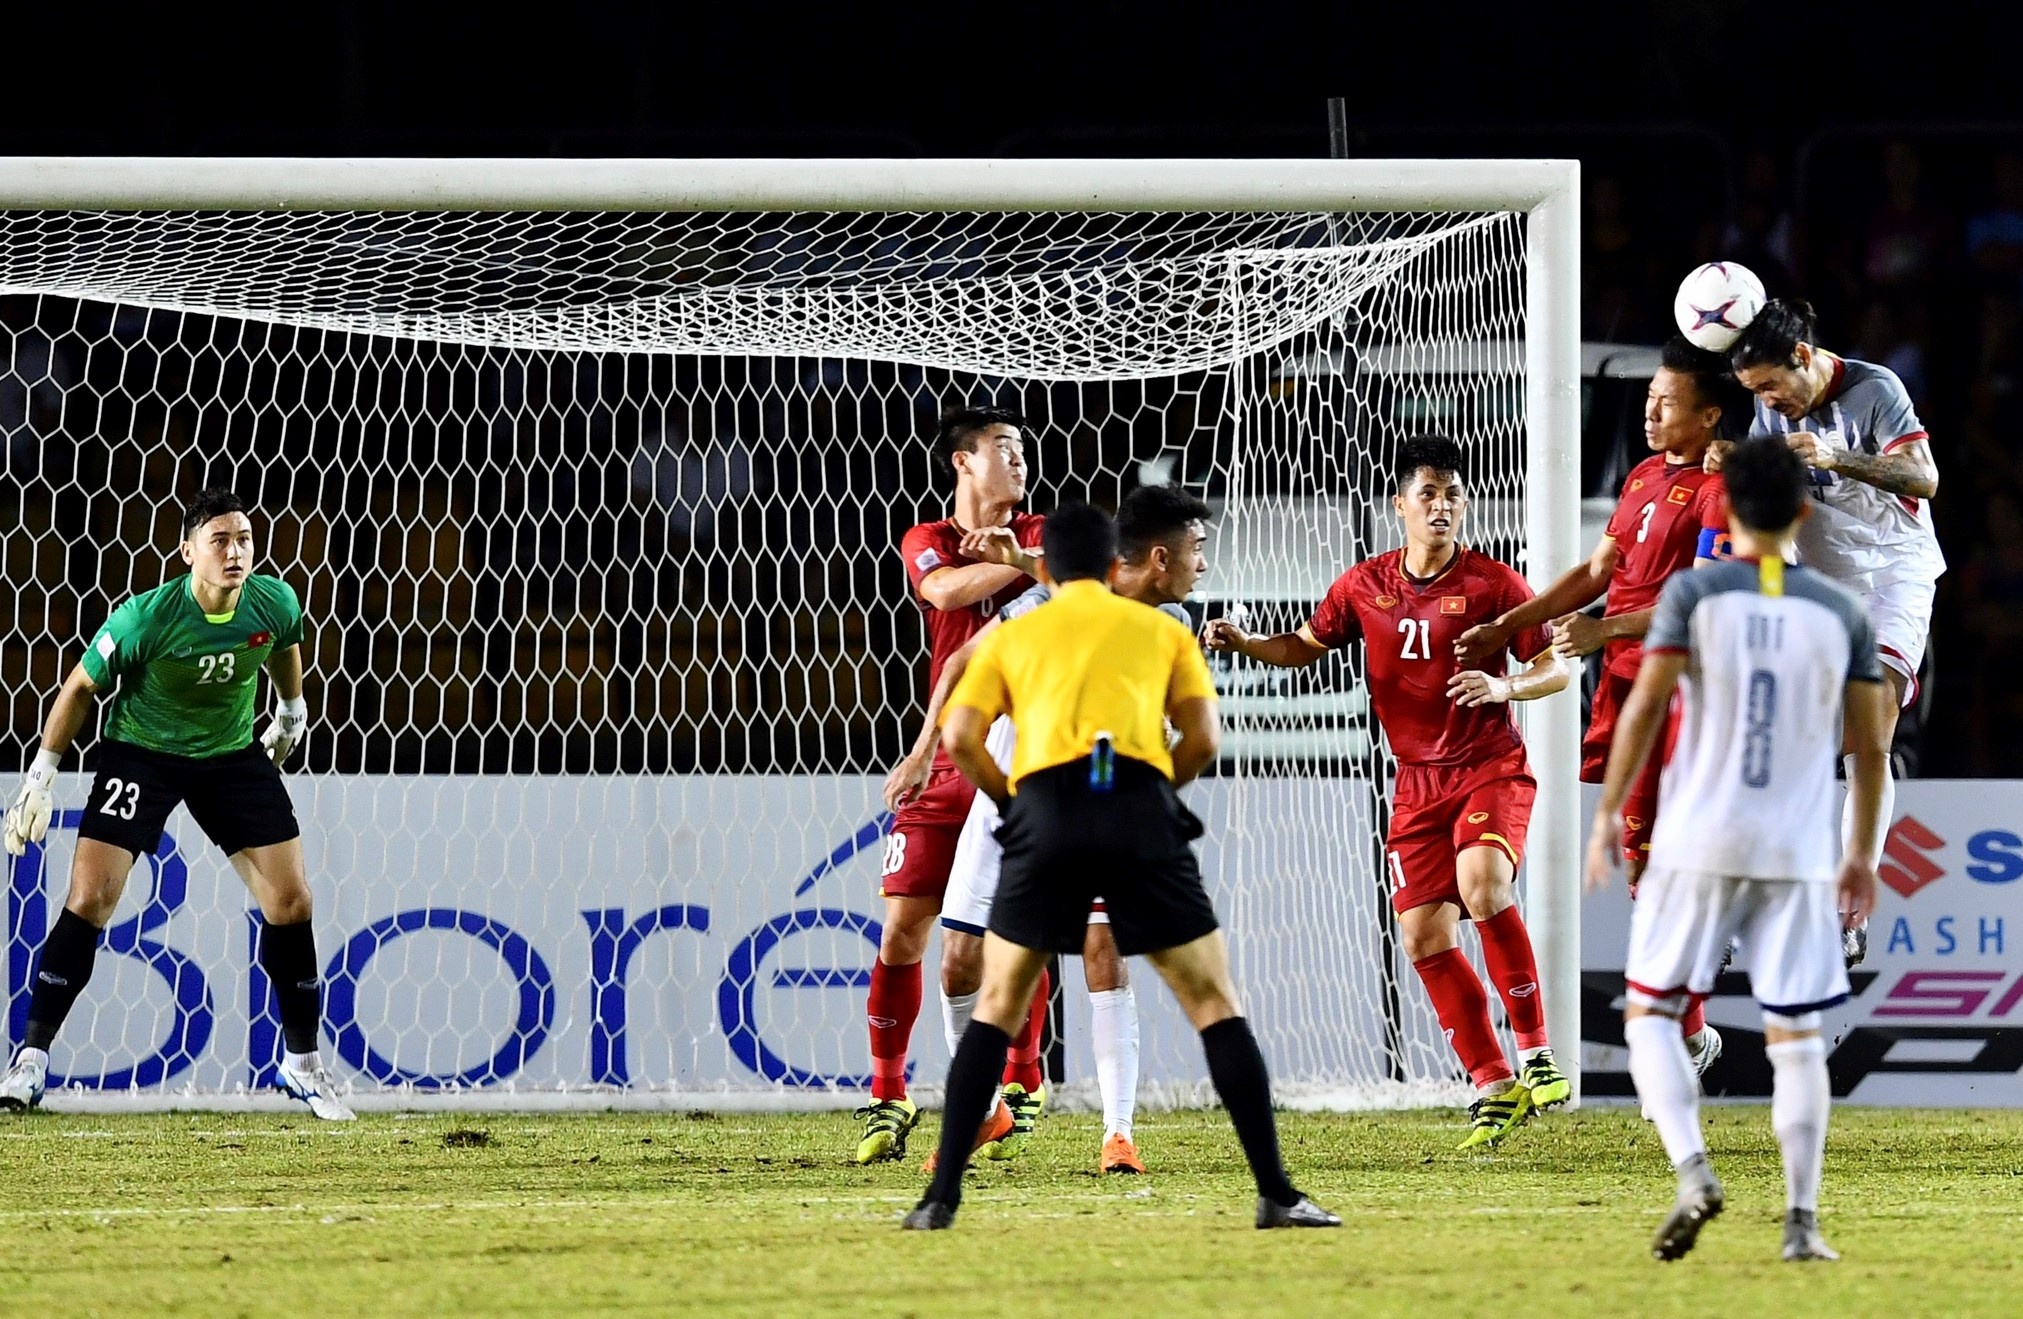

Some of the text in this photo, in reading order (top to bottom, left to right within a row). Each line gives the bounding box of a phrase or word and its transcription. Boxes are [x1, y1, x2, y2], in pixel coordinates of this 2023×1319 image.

[1637, 501, 1656, 543] 3
[1398, 618, 1430, 659] 21
[196, 652, 235, 685] 23
[1742, 668, 1777, 788] 8
[100, 777, 140, 820] 23
